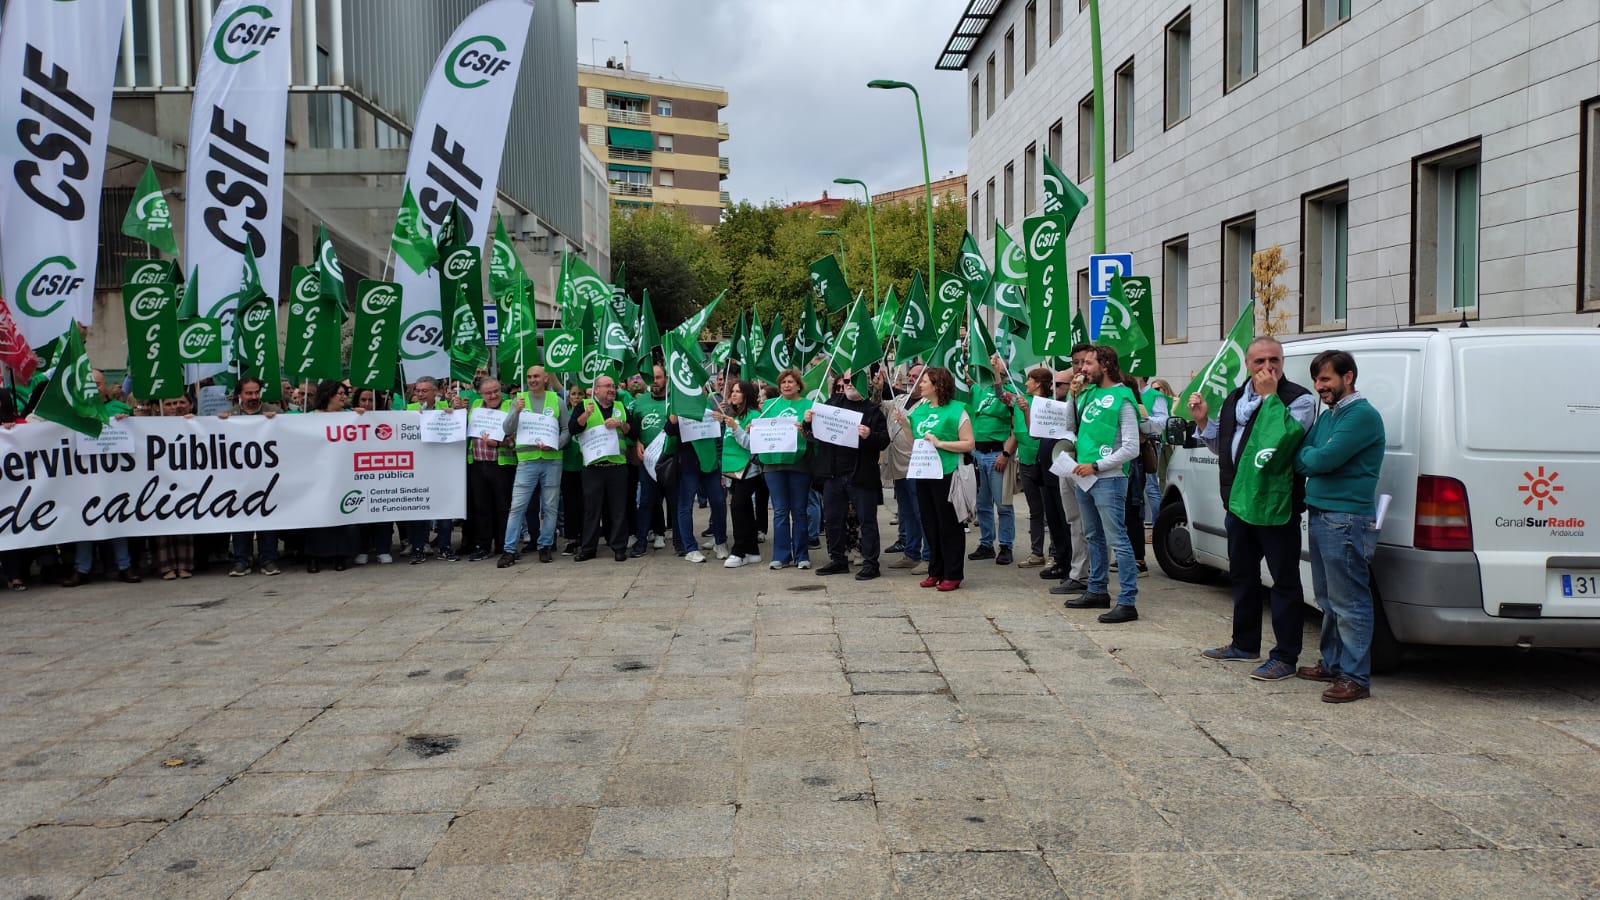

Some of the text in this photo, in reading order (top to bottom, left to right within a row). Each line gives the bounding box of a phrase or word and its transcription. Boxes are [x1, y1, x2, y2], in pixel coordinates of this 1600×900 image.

[227, 22, 281, 46] CSIF
[458, 49, 512, 77] CSIF
[14, 42, 95, 221] CSIF
[203, 104, 270, 258] CSIF
[419, 123, 484, 271] SIF
[1036, 232, 1061, 248] CSIF
[449, 258, 477, 271] CSIF
[964, 259, 984, 282] CSIF
[137, 272, 168, 284] CSIF
[1097, 259, 1124, 293] P
[31, 274, 85, 297] CSIF
[942, 284, 965, 298] CSIF
[137, 297, 170, 310] CSIF
[368, 293, 398, 307] CSIF
[248, 308, 271, 321] CSIF
[185, 333, 216, 347] CSIF
[406, 323, 443, 347] CSI
[551, 344, 579, 357] CSIF
[584, 358, 613, 373] CSIF
[326, 424, 370, 442] UGT
[401, 423, 421, 431] Serv
[401, 432, 421, 441] Públi
[0, 438, 136, 482] ervicios
[147, 432, 280, 472] Públicos
[357, 454, 410, 468] CCOO
[354, 470, 414, 481] área pública
[400, 486, 430, 494] Sindical
[0, 473, 281, 534] de calidad
[344, 496, 366, 507] CSIF
[370, 496, 424, 505] Independiente
[382, 504, 431, 512] Funcionarios
[1495, 516, 1585, 528] CanalSurRadio
[1550, 529, 1584, 537] Andalucía
